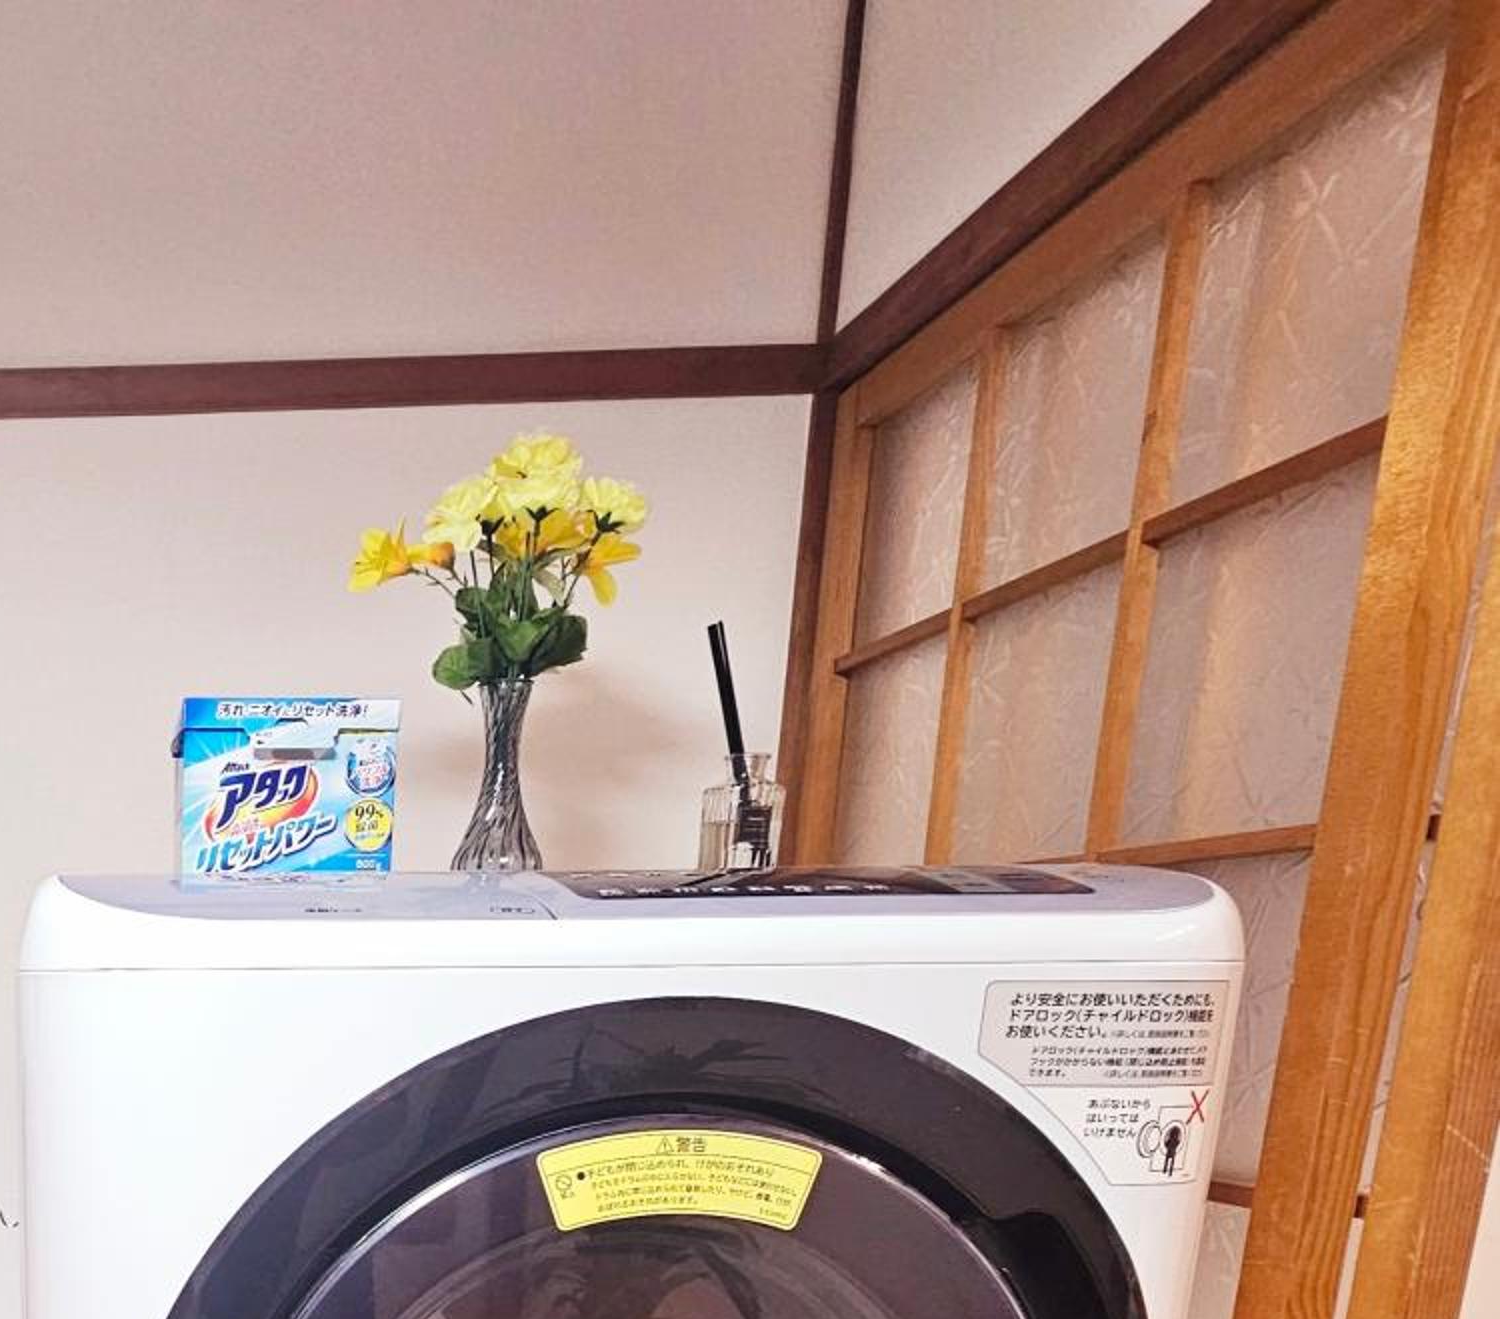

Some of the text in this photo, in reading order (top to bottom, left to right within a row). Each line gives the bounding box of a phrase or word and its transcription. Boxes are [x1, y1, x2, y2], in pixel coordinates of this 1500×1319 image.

[217, 765, 308, 829] アタック
[196, 815, 335, 873] リセットパワー
[1009, 992, 1216, 1008] より安全にお使いいただくためにも、
[1005, 1025, 1108, 1039] お使いください。
[1087, 1099, 1152, 1110] あぶないから
[1085, 1113, 1140, 1123] はいっては
[1083, 1127, 1137, 1138] いけません
[675, 1136, 709, 1153] 警告
